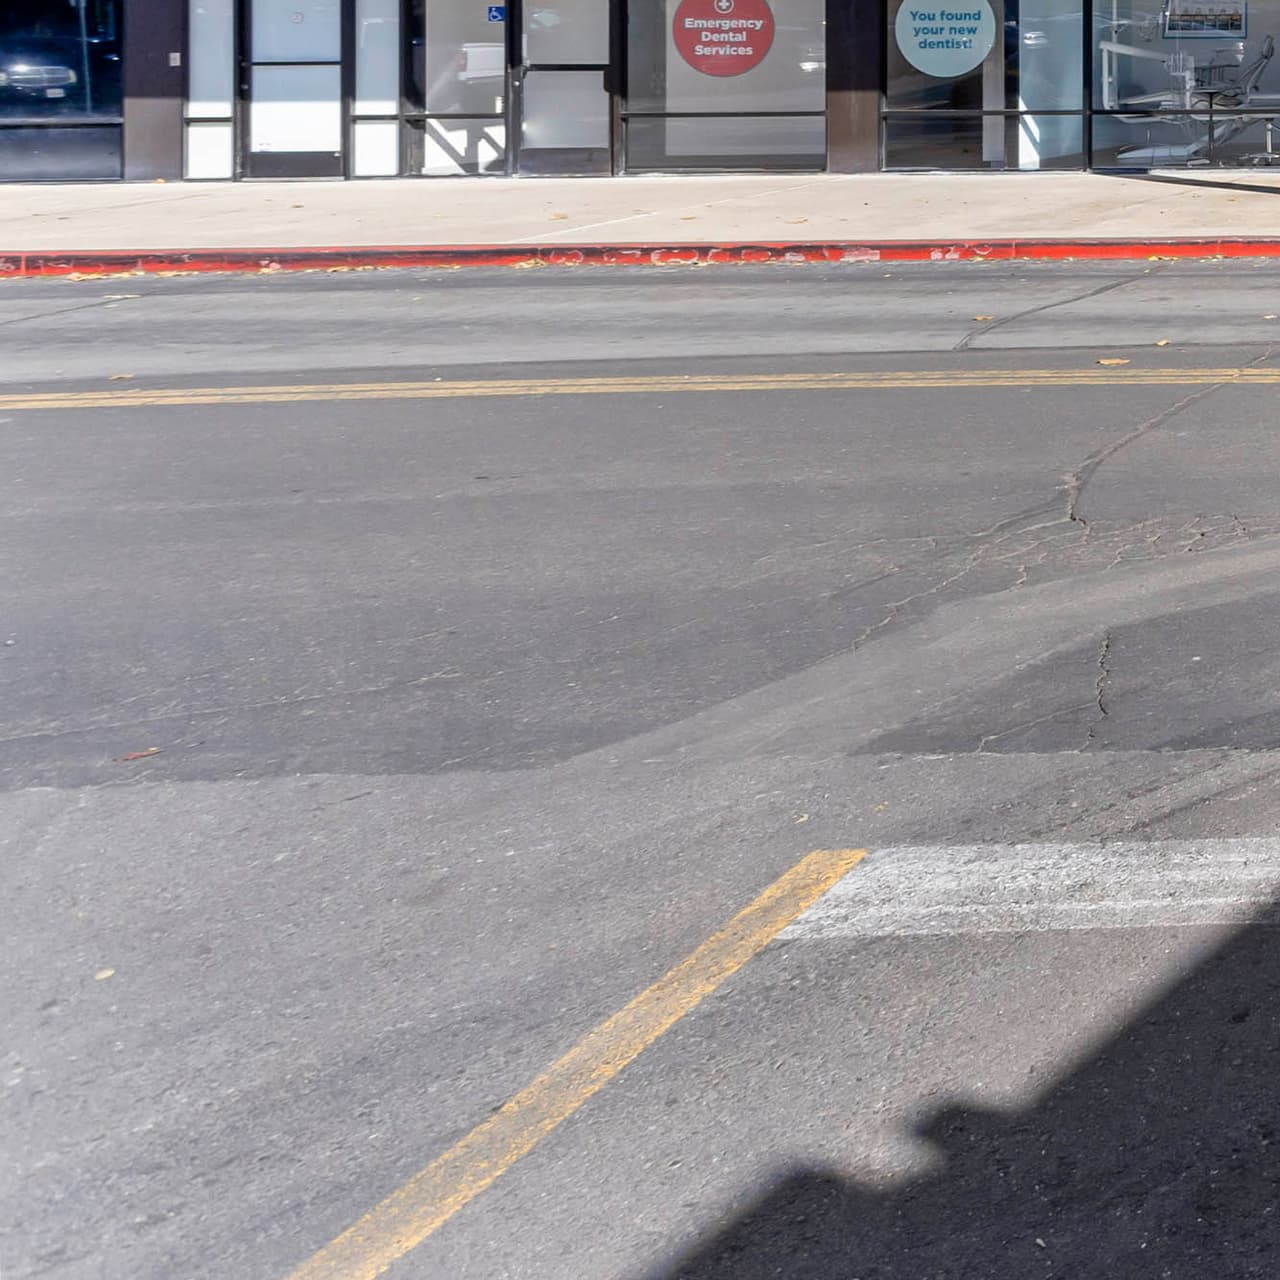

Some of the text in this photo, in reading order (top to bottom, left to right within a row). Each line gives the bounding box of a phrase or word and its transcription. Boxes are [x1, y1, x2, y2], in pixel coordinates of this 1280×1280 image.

[910, 10, 982, 21] You found
[684, 18, 764, 30] Emergency
[701, 31, 747, 41] Dental
[913, 26, 978, 37] your new
[694, 44, 753, 55] Services
[918, 39, 973, 49] dentist!
